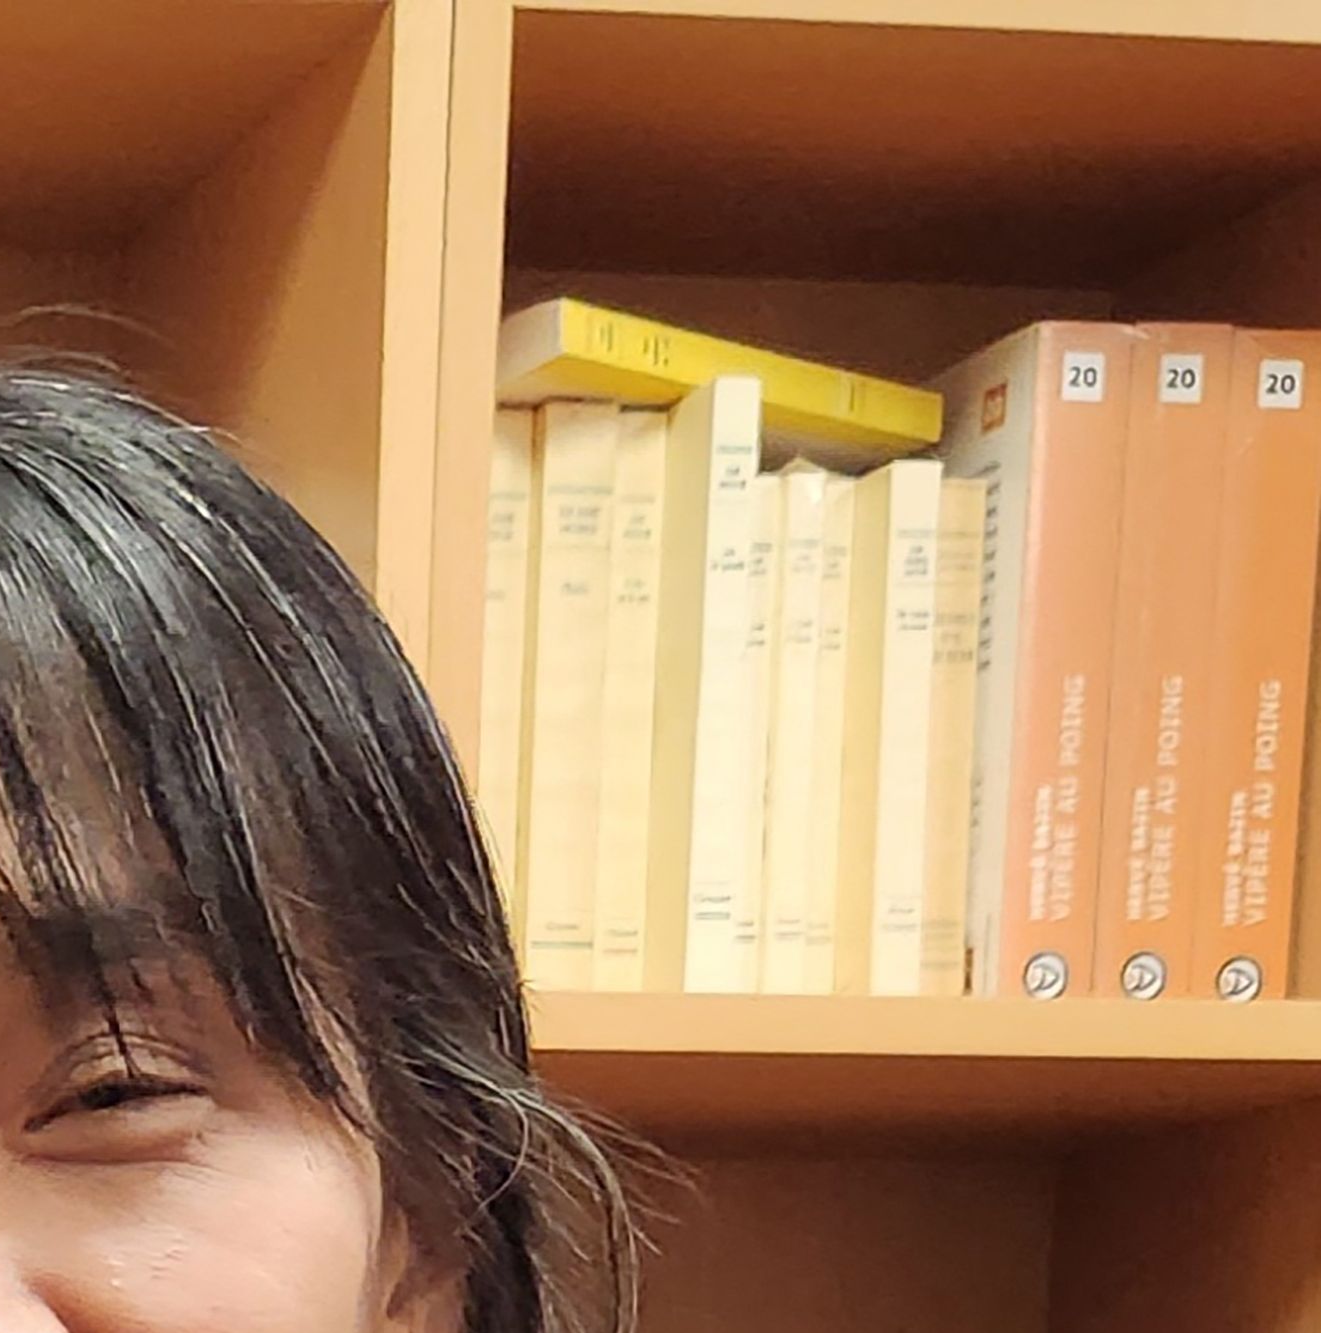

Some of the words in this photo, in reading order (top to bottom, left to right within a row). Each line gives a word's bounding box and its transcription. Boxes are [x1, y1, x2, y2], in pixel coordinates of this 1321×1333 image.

[1070, 366, 1097, 387] 20
[1167, 368, 1196, 389] 20
[1266, 373, 1296, 395] 20
[1061, 674, 1084, 766] POING
[1158, 675, 1183, 766] POING
[1255, 679, 1281, 771] POING
[1056, 776, 1079, 813] AU
[1153, 776, 1177, 814] AU
[1251, 782, 1274, 819] AU
[1146, 825, 1173, 921] VIPÈRE
[1241, 829, 1270, 927] VIPÈRE
